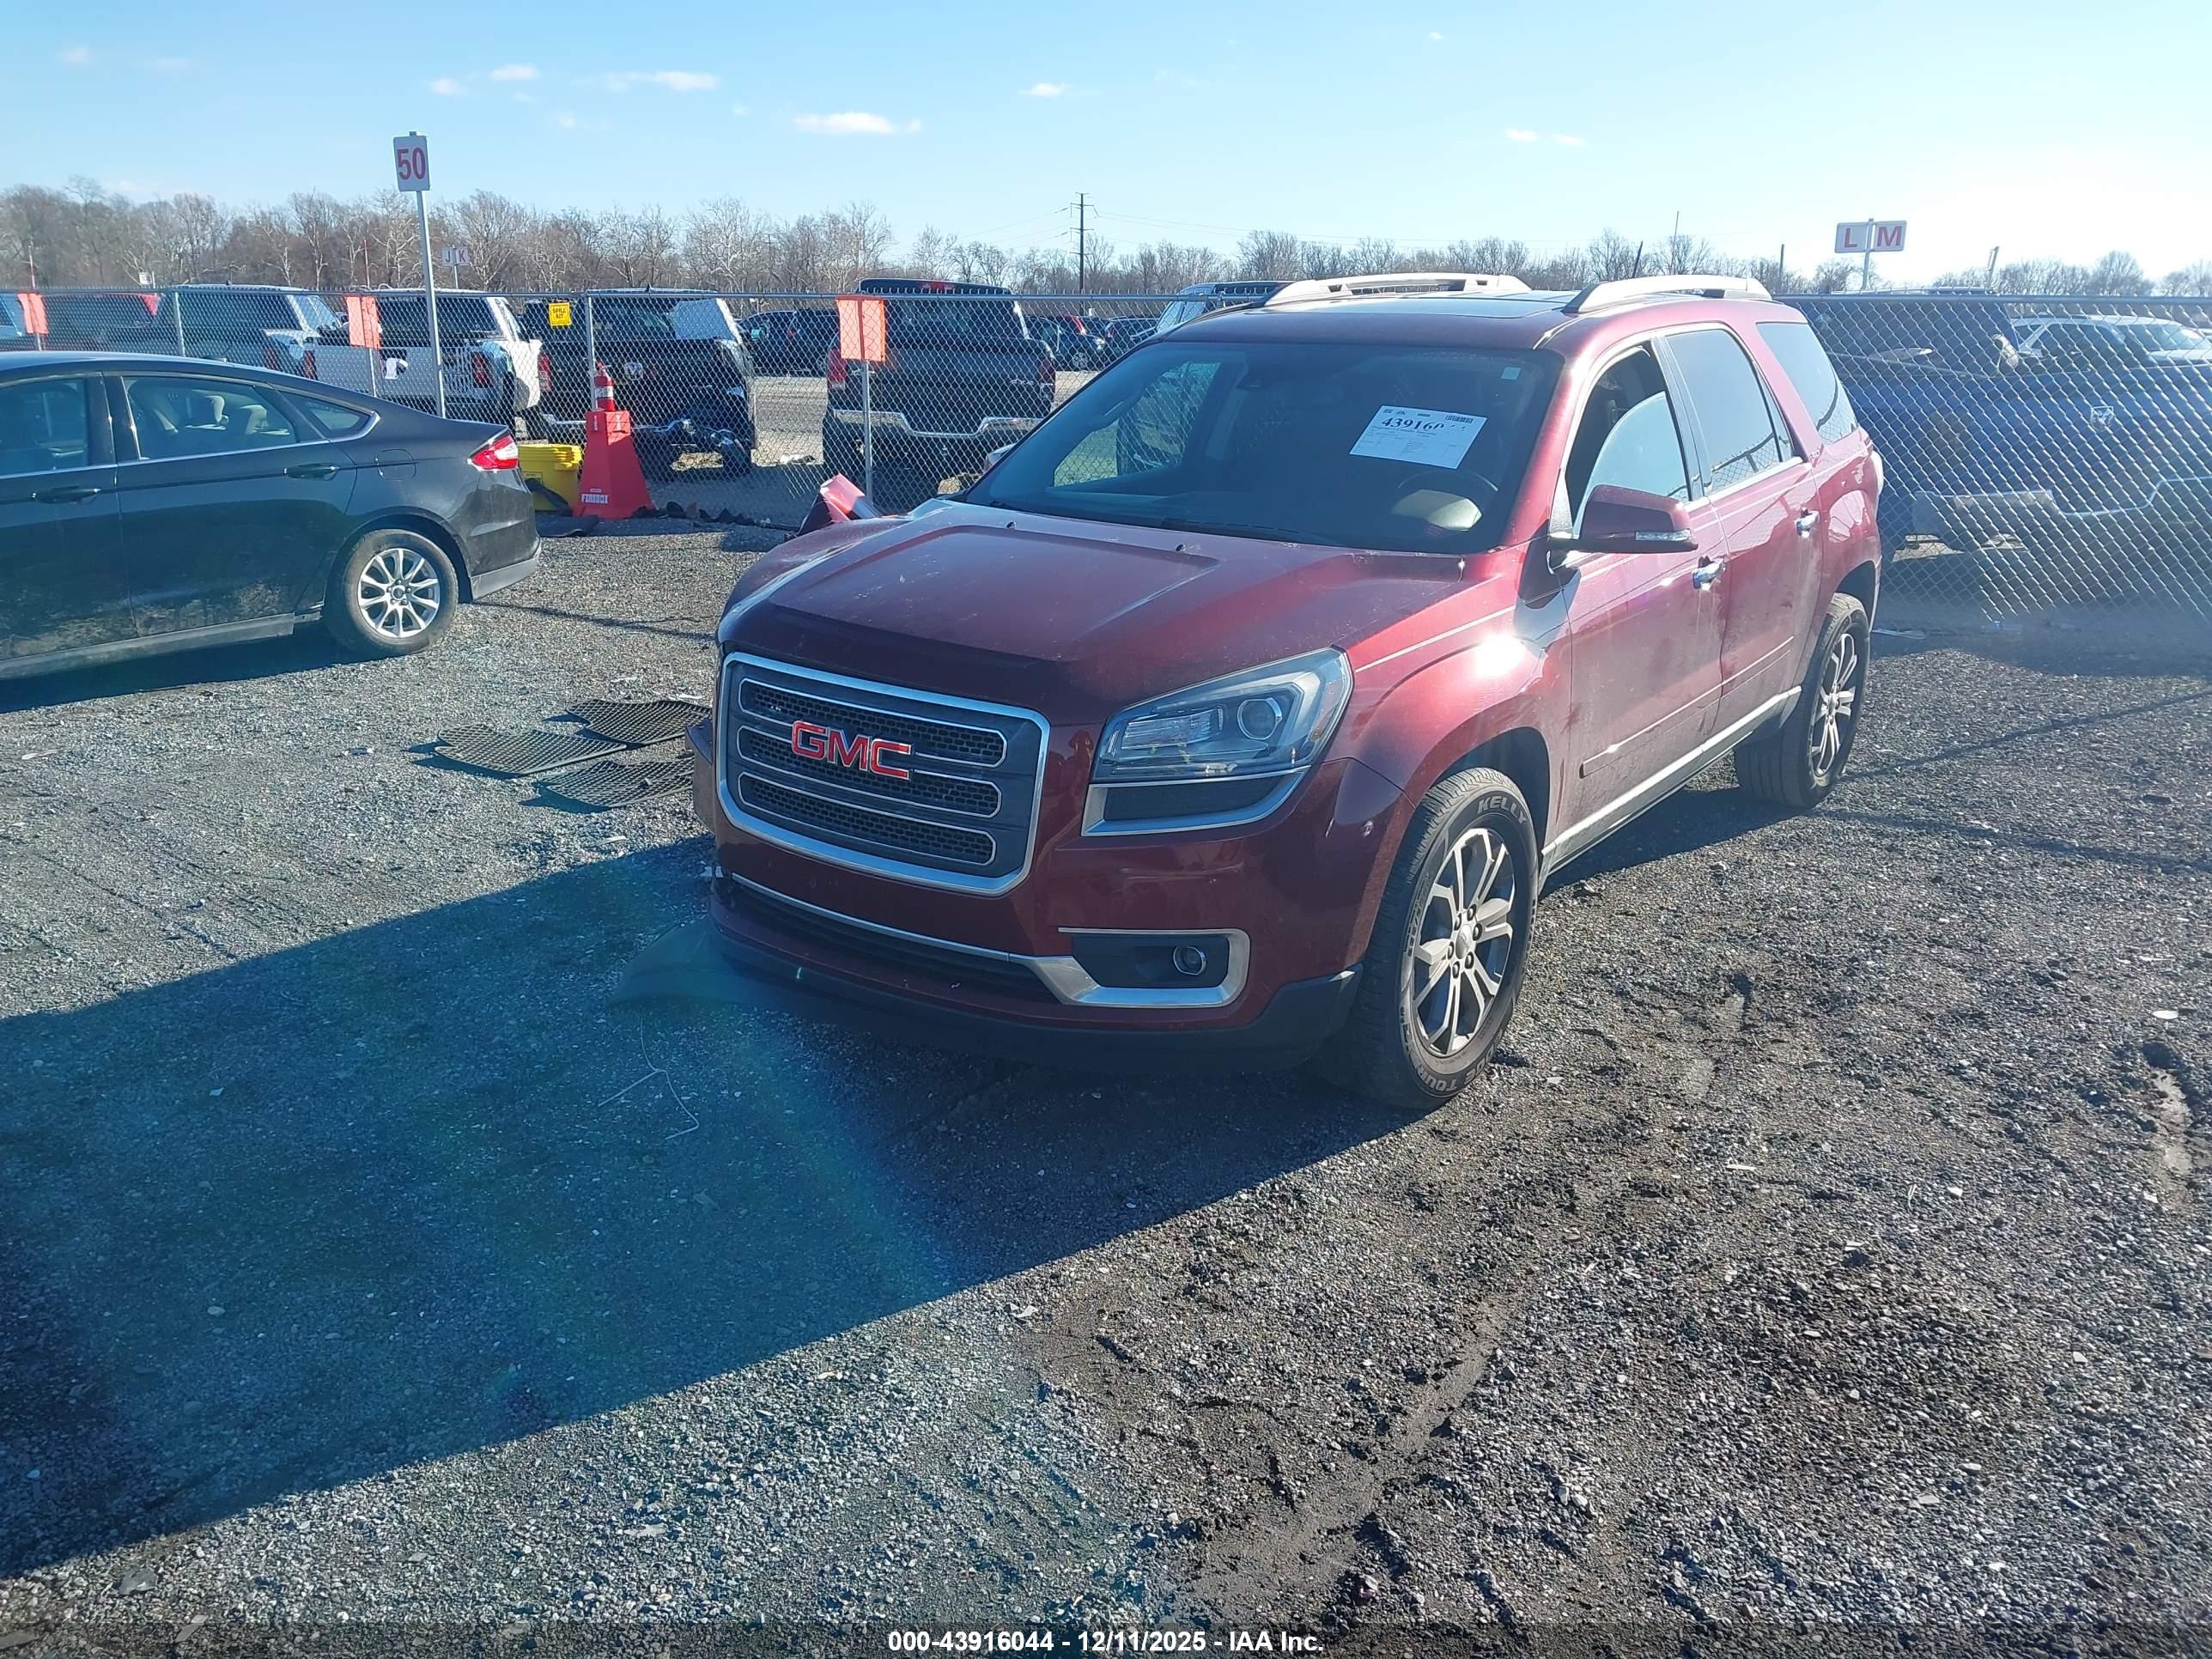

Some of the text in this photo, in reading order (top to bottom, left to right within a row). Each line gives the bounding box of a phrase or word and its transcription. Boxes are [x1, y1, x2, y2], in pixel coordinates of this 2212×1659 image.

[398, 147, 426, 180] 50
[1844, 226, 1903, 248] L M
[445, 250, 466, 263] J K
[792, 720, 913, 781] GMC
[1477, 795, 1527, 824] KELLY
